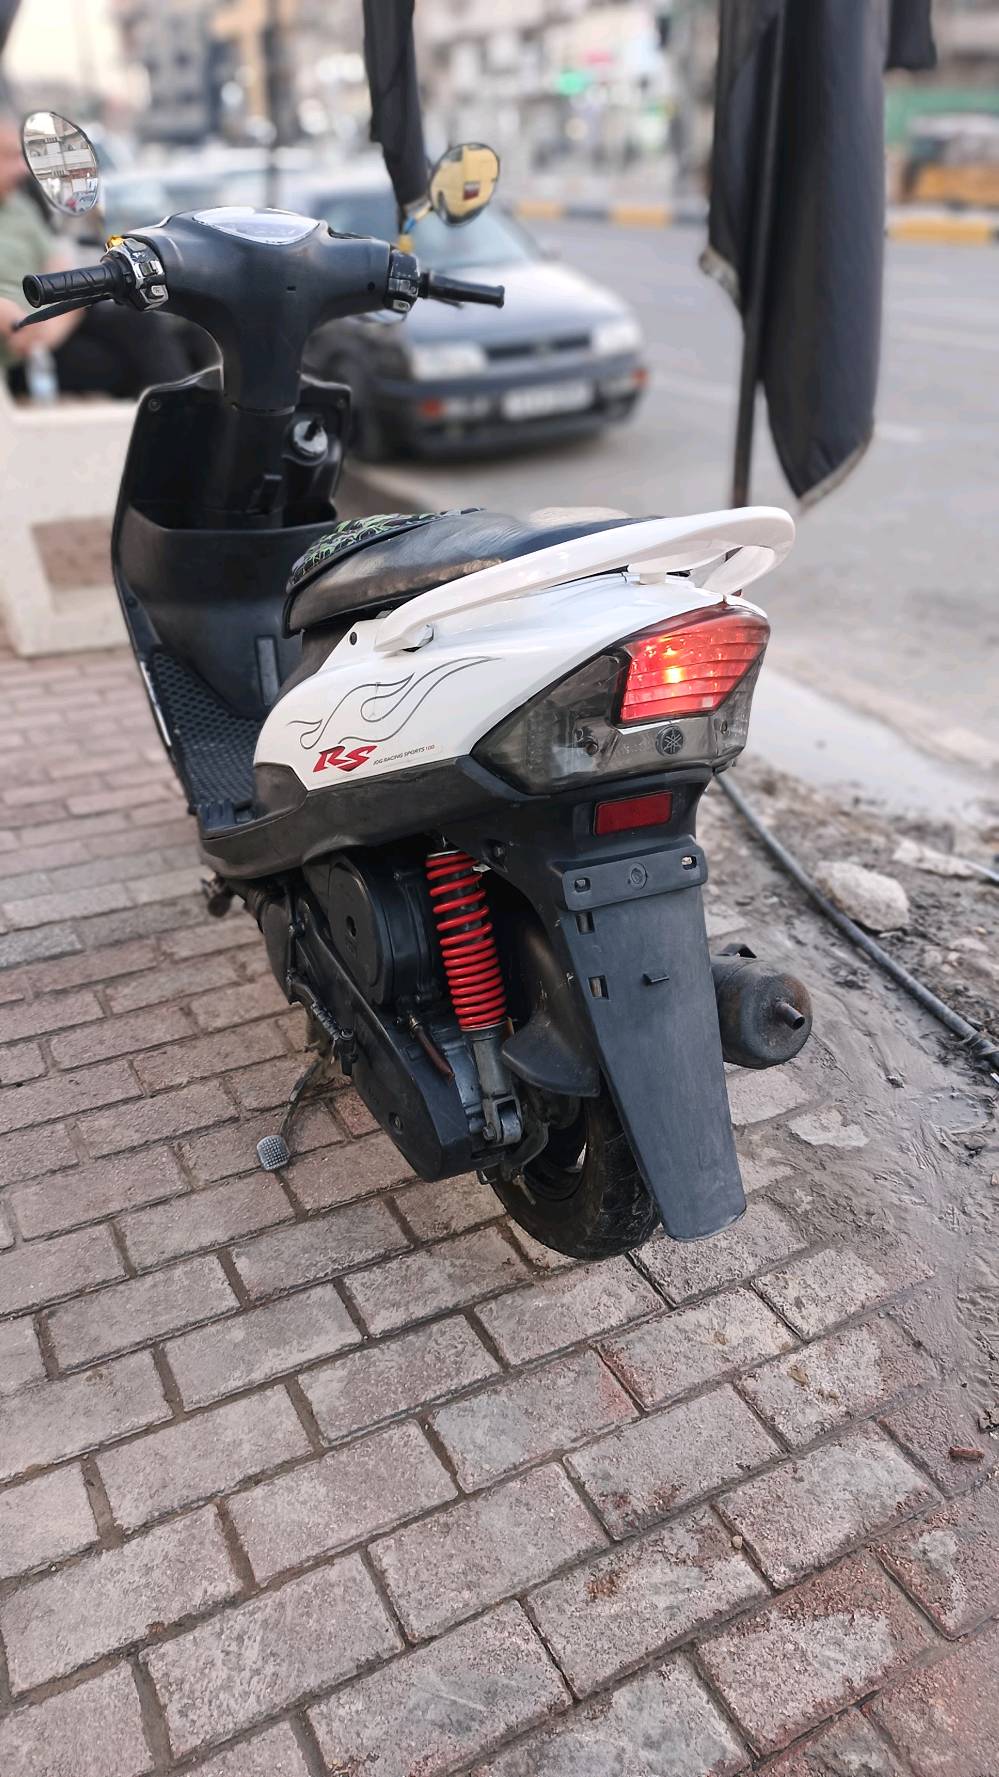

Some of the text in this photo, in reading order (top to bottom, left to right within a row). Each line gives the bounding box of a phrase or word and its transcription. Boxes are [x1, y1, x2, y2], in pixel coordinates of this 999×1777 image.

[313, 745, 378, 772] RS
[384, 753, 403, 762] RACING
[404, 746, 424, 757] SPORTS
